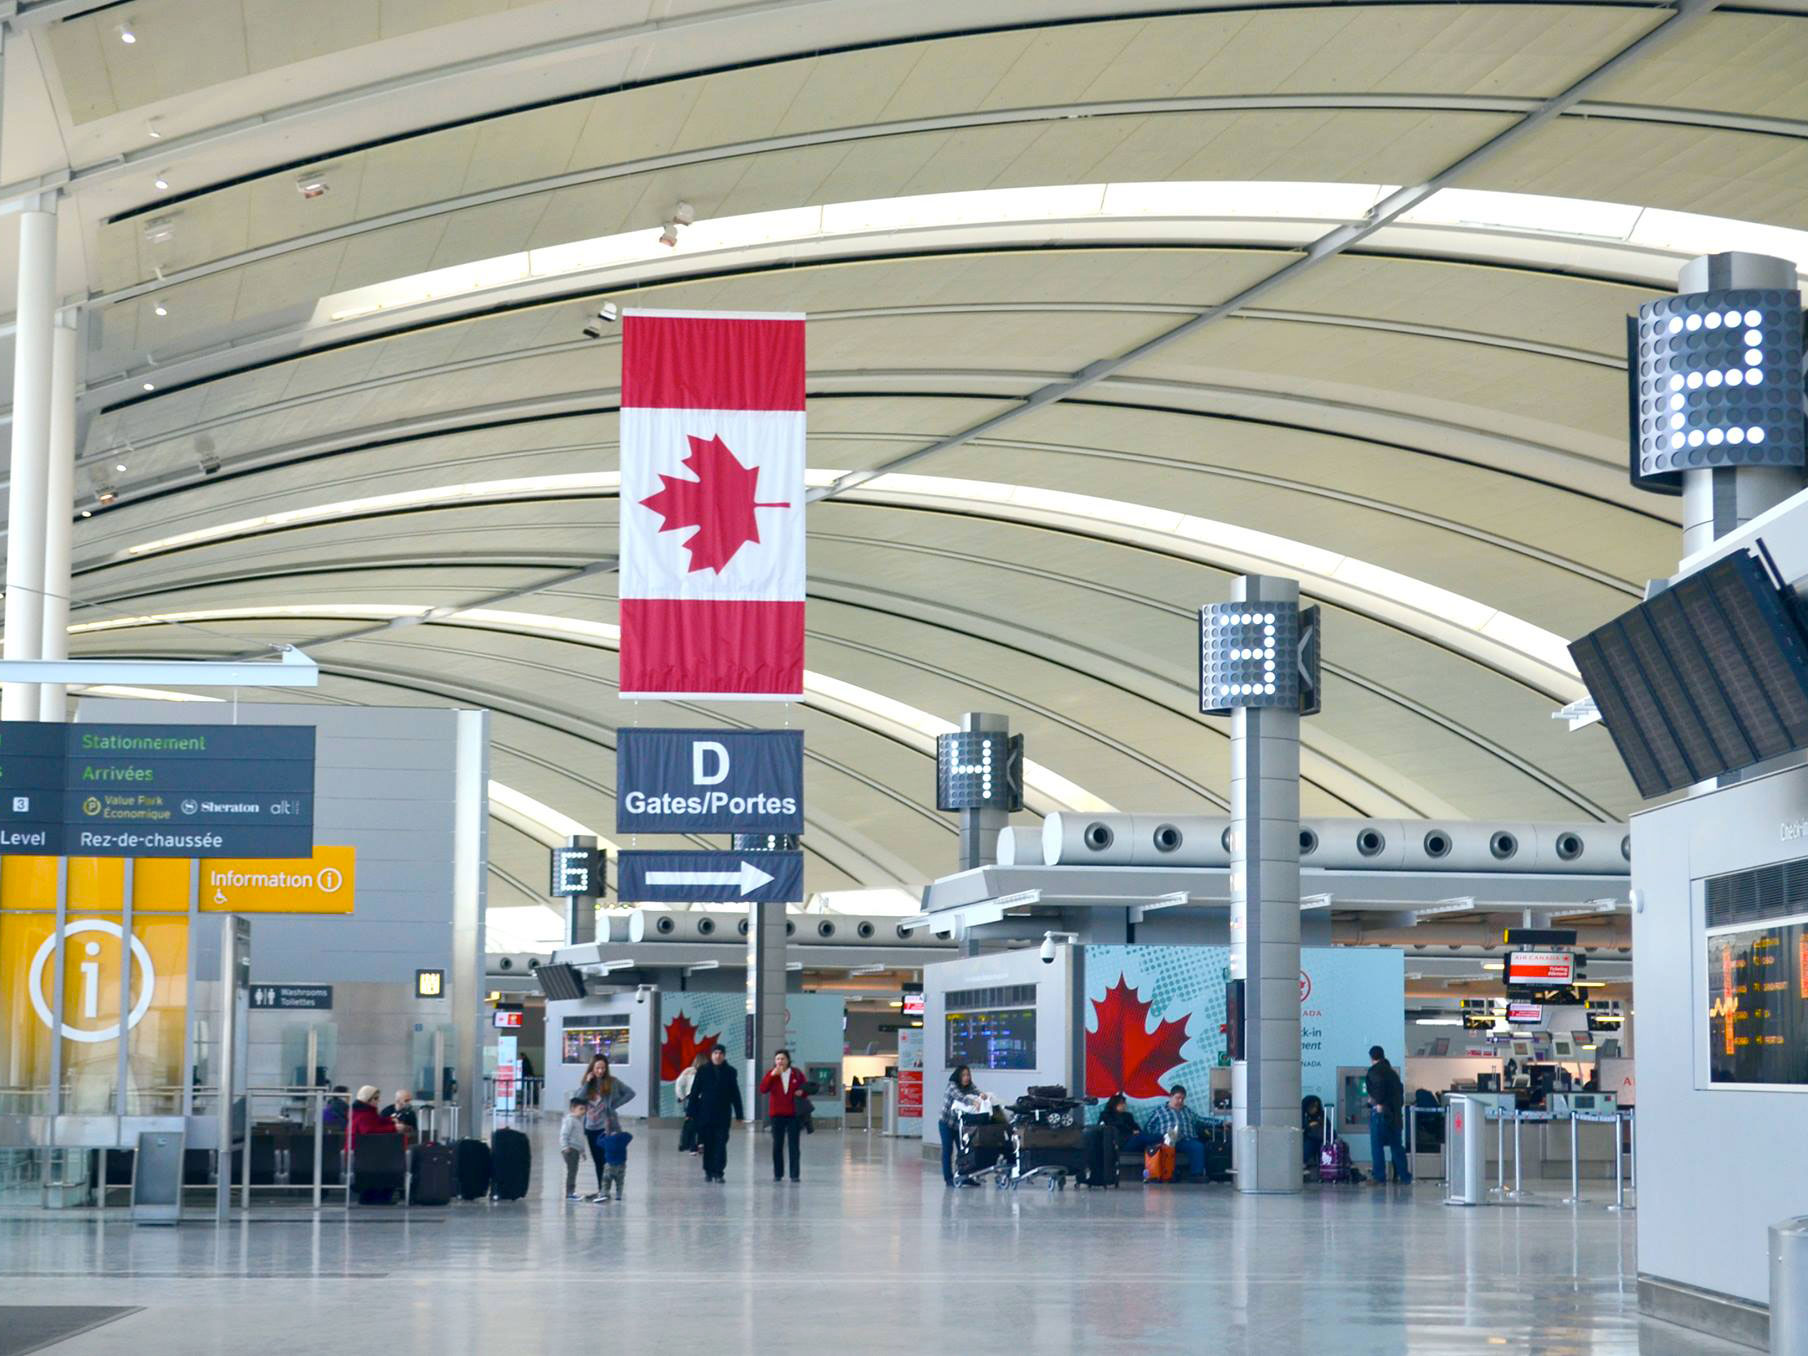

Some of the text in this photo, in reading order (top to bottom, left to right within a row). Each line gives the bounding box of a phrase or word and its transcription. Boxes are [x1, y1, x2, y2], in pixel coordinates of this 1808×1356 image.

[1668, 309, 1765, 450] 2
[1220, 613, 1276, 696] 3
[81, 734, 207, 750] Stationnement
[692, 740, 730, 786] D
[951, 739, 992, 800] 4
[82, 766, 153, 781] Arrivées
[104, 796, 164, 805] Value Park
[201, 802, 260, 813] Sheraton
[270, 800, 291, 815] alt
[624, 791, 797, 815] Gates/Portes
[103, 808, 171, 820] Économique
[0, 830, 46, 846] Level
[81, 832, 223, 848] Rez-de-chaussée
[211, 870, 313, 887] Information
[560, 851, 589, 892] 6
[281, 988, 328, 997] Washrooms
[280, 998, 316, 1006] Toilettes
[1300, 1027, 1322, 1037] k-in
